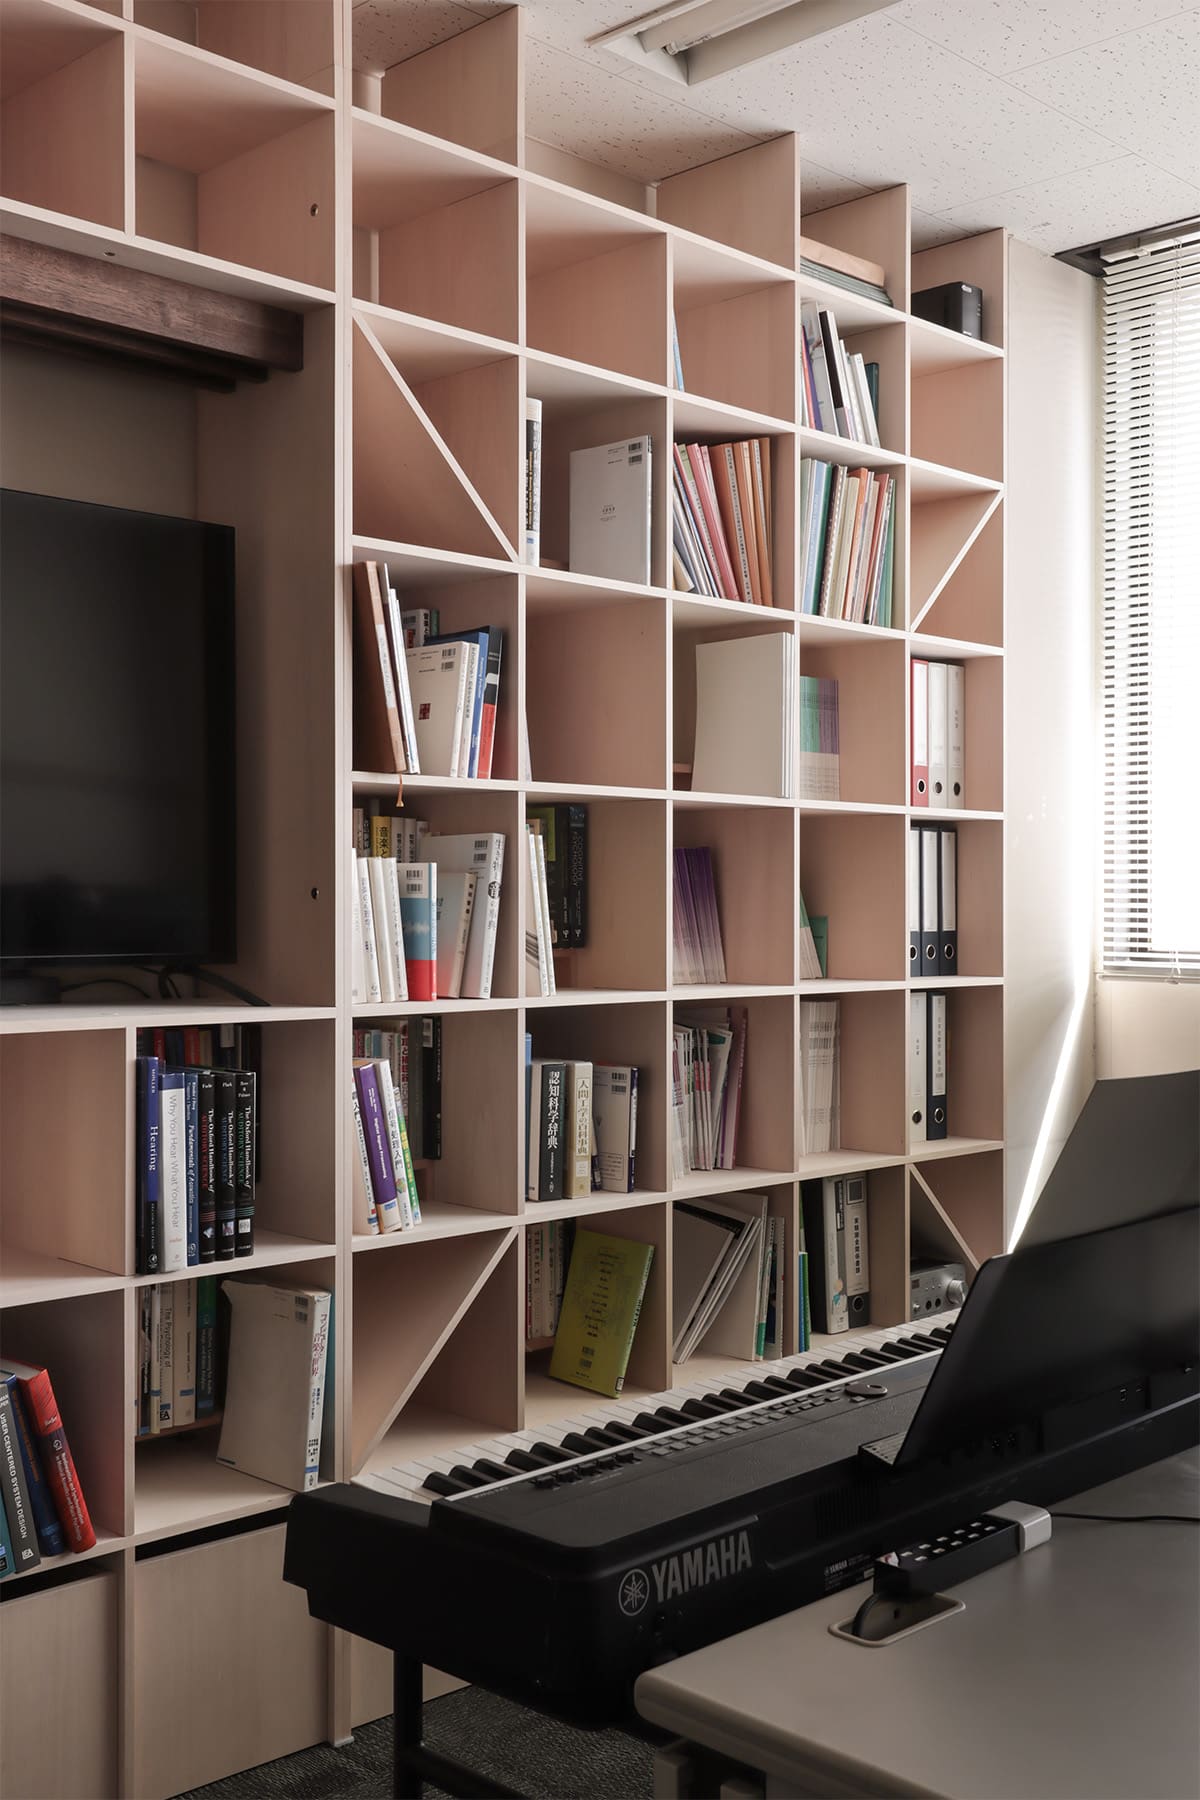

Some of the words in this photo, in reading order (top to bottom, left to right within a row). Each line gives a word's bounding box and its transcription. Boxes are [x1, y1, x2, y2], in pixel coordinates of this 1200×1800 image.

[168, 1094, 178, 1117] Why
[547, 1071, 560, 1150] 認知科学辞典
[578, 1080, 589, 1154] 人間工学の百科事典
[170, 1118, 178, 1136] You
[388, 1110, 404, 1170] 信号処理入門
[149, 1126, 158, 1171] Hearing
[170, 1138, 178, 1160] Hear
[171, 1162, 179, 1186] What
[208, 1183, 214, 1192] of
[227, 1179, 234, 1188] of
[244, 1180, 251, 1189] of
[0, 1413, 8, 1436] USER
[3, 1435, 16, 1477] CENTERED
[11, 1477, 22, 1509] SYSTEM
[16, 1509, 27, 1539] DESIGN
[651, 1530, 752, 1603] YAMAHA
